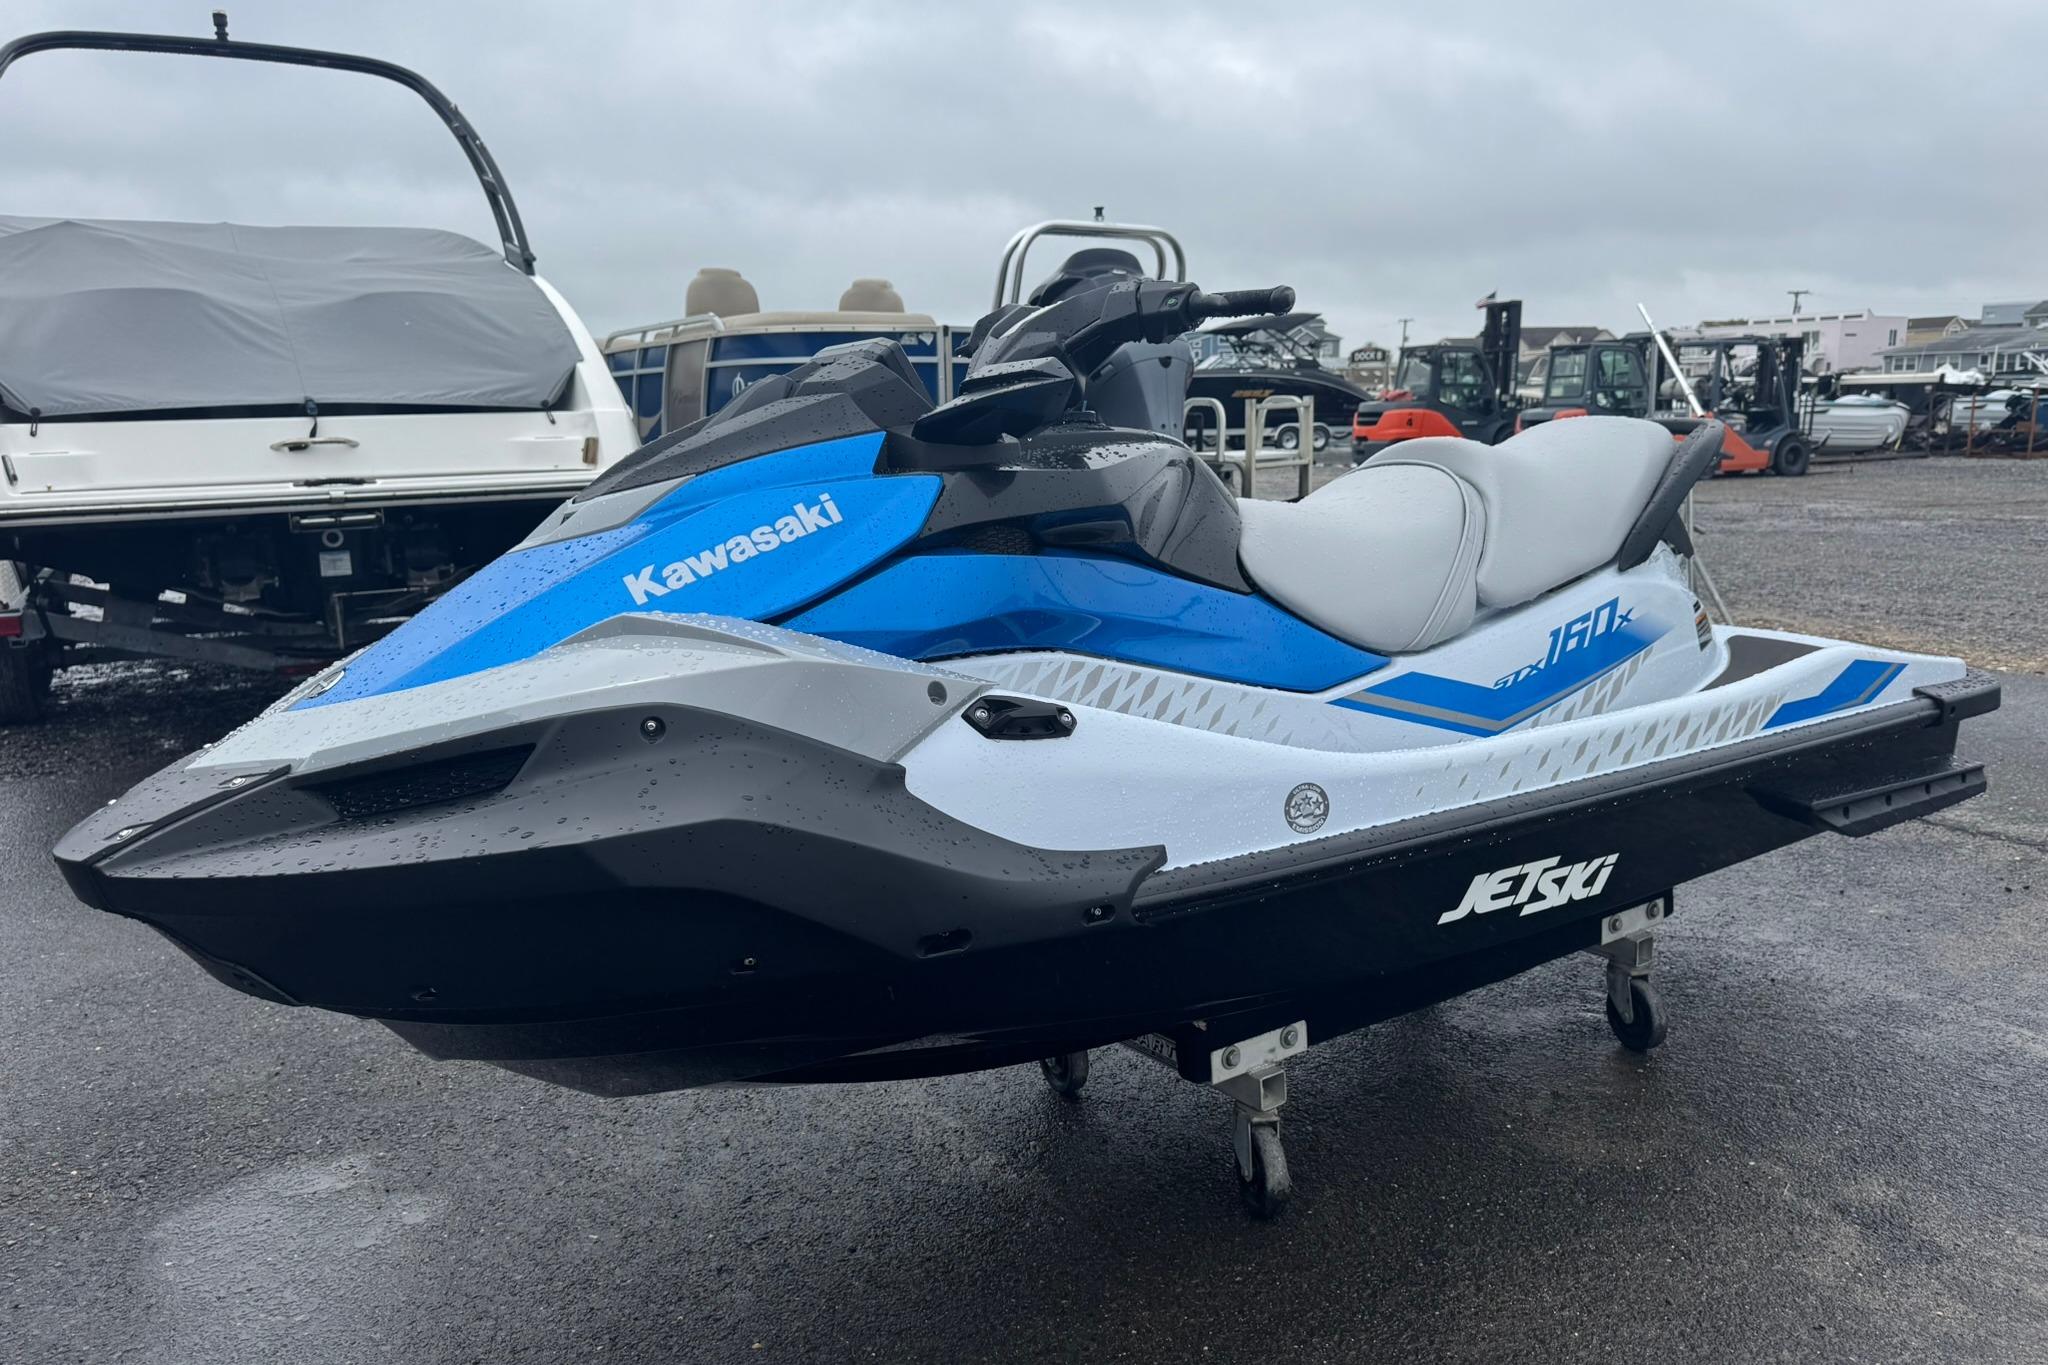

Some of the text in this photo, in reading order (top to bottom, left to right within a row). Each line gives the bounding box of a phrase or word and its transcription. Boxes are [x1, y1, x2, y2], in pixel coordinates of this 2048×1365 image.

[1354, 351, 1376, 361] DOCK
[622, 492, 844, 606] Kawasaki
[1292, 819, 1324, 833] EMISSION
